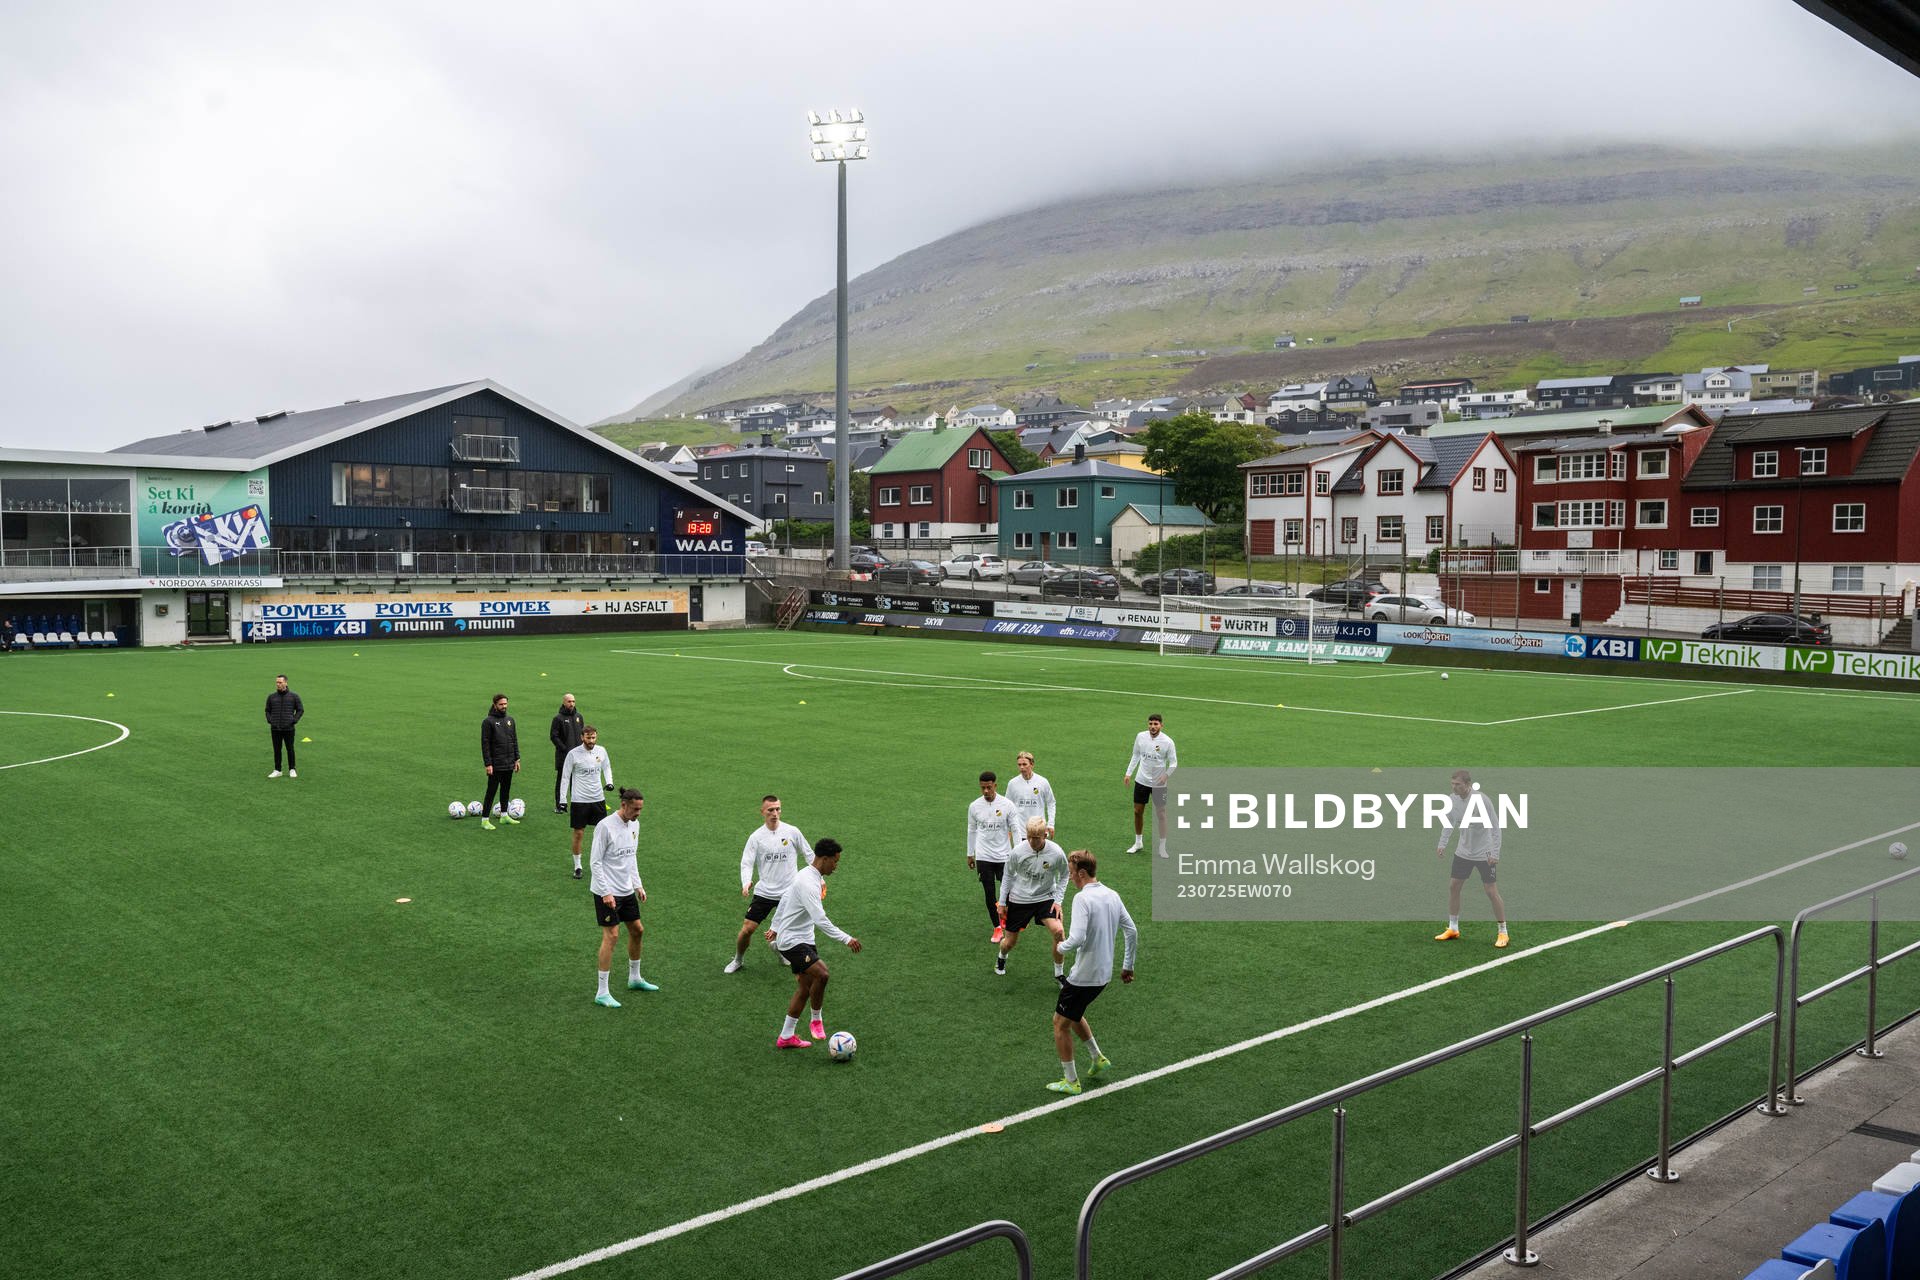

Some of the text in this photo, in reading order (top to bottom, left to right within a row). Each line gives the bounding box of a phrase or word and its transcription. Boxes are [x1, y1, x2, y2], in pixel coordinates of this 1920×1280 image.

[148, 486, 172, 500] Set
[148, 500, 158, 514] á
[677, 510, 683, 519] H
[713, 511, 719, 519] G
[687, 523, 712, 534] 19:28
[675, 540, 733, 552] WAAG
[210, 579, 263, 588] SPARIKASSI
[262, 603, 346, 620] POMEK
[375, 602, 453, 618] POMEK
[479, 600, 550, 616] POMEK
[605, 600, 668, 613] HJ ASFALT
[468, 618, 515, 630] munin
[1127, 614, 1170, 624] RENAUT
[293, 621, 322, 636] kbi.fo
[334, 621, 366, 635] KBI
[394, 620, 444, 632] munin
[1059, 627, 1075, 636] effo
[1313, 624, 1371, 636] WWW.KJ.FO
[1403, 631, 1450, 642] LOOK NORTH
[1491, 637, 1543, 648] LOOK NORTH
[1592, 639, 1634, 658] KBI
[1686, 643, 1761, 668] Teknik
[1838, 653, 1920, 679] Teknik
